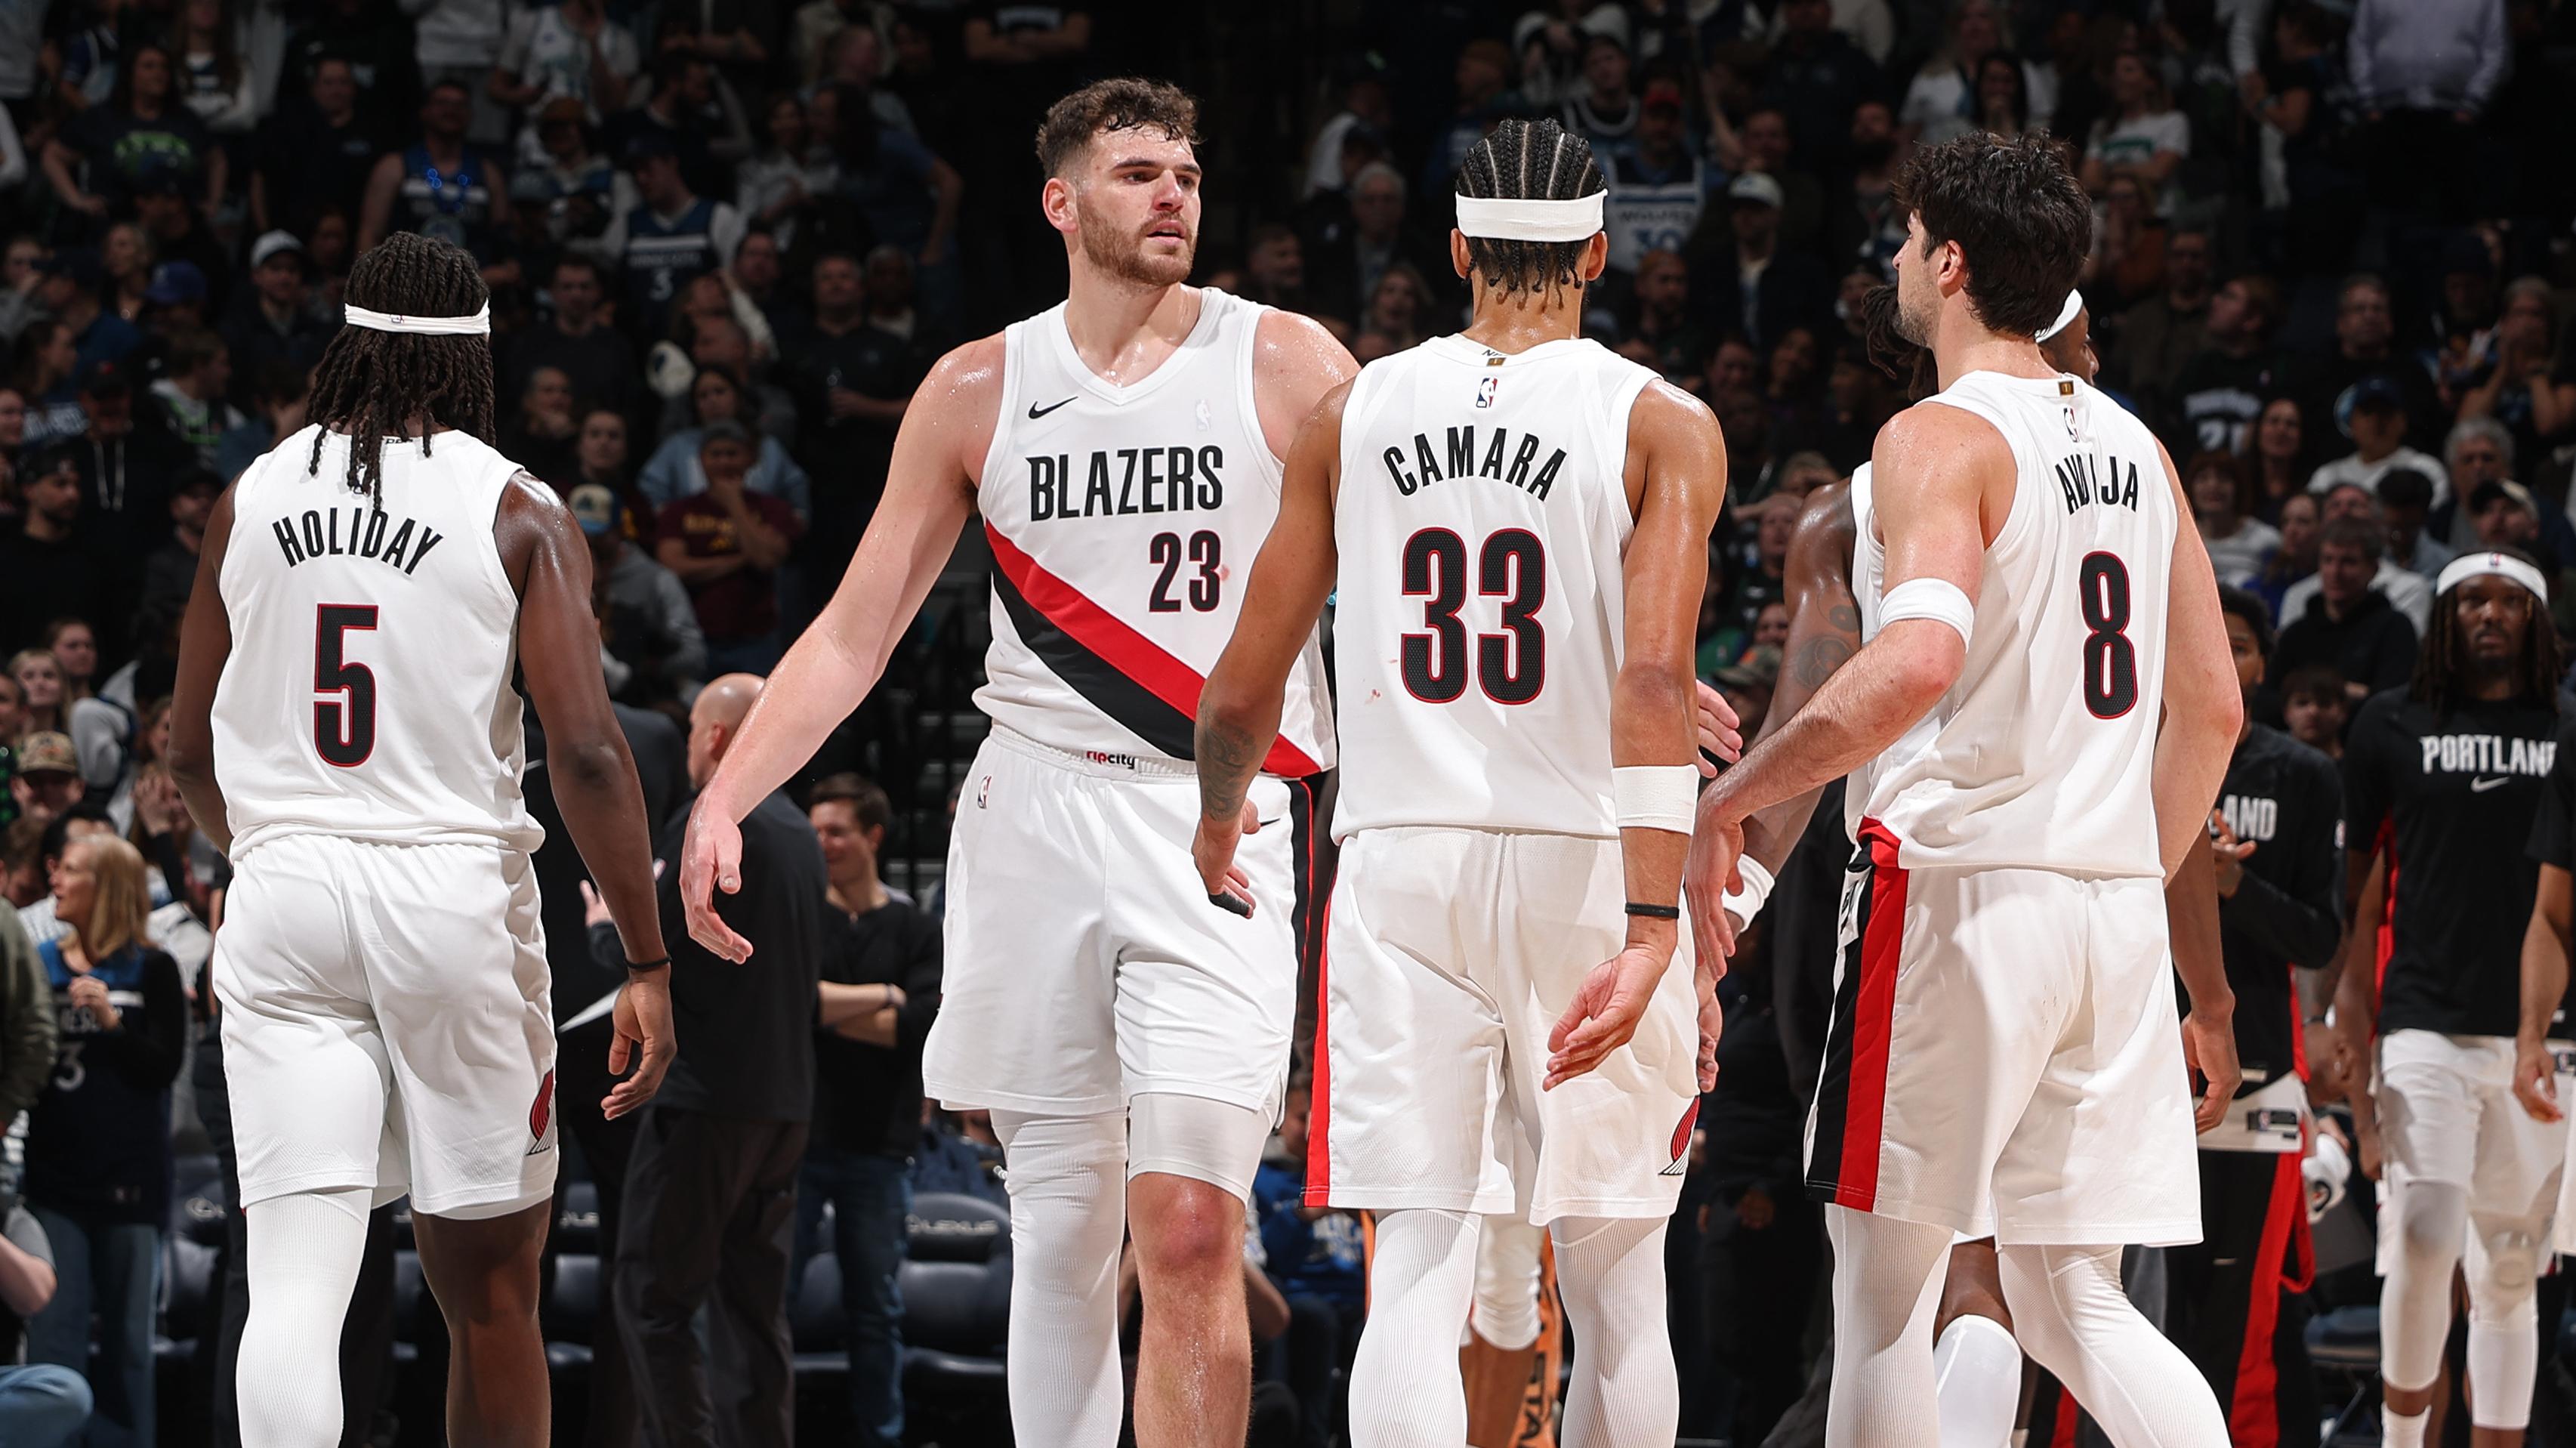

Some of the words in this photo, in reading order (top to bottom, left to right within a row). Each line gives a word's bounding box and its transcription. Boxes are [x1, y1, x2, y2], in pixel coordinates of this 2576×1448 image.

[1026, 445, 1223, 522] BLAZERS
[1383, 425, 1567, 502] CAMARA
[272, 508, 443, 575] HOLIDAY
[1149, 529, 1221, 613] 23
[1400, 526, 1546, 705] 33
[2078, 550, 2139, 720] 8
[313, 603, 379, 768] 5
[1087, 751, 1136, 770] ripcity
